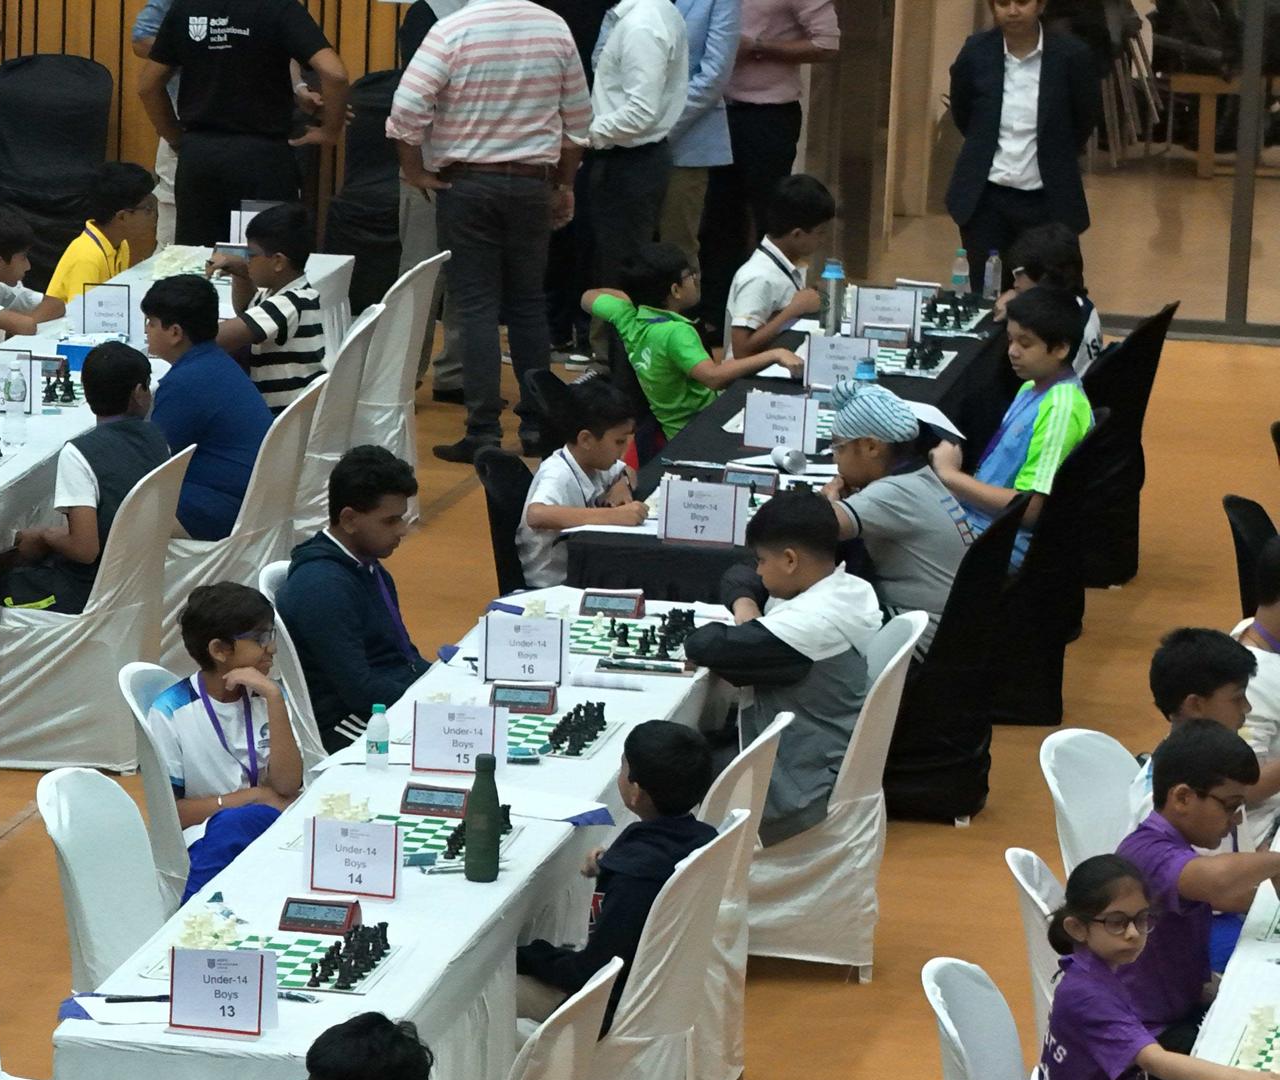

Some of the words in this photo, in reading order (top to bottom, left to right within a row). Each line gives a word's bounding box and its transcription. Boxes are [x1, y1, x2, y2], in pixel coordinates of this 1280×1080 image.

[775, 435, 786, 444] 18
[683, 502, 717, 511] Under-14
[694, 525, 705, 534] 17
[509, 640, 546, 648] Under-14
[521, 665, 534, 674] 16
[443, 726, 483, 736] Under-14
[452, 740, 474, 749] Boys
[456, 754, 470, 764] 15
[335, 844, 377, 856] Under-14
[344, 858, 367, 868] Boys
[348, 874, 362, 884] 14
[203, 975, 248, 985] Under-14
[214, 989, 239, 1000] Boys
[219, 1006, 235, 1018] 13
